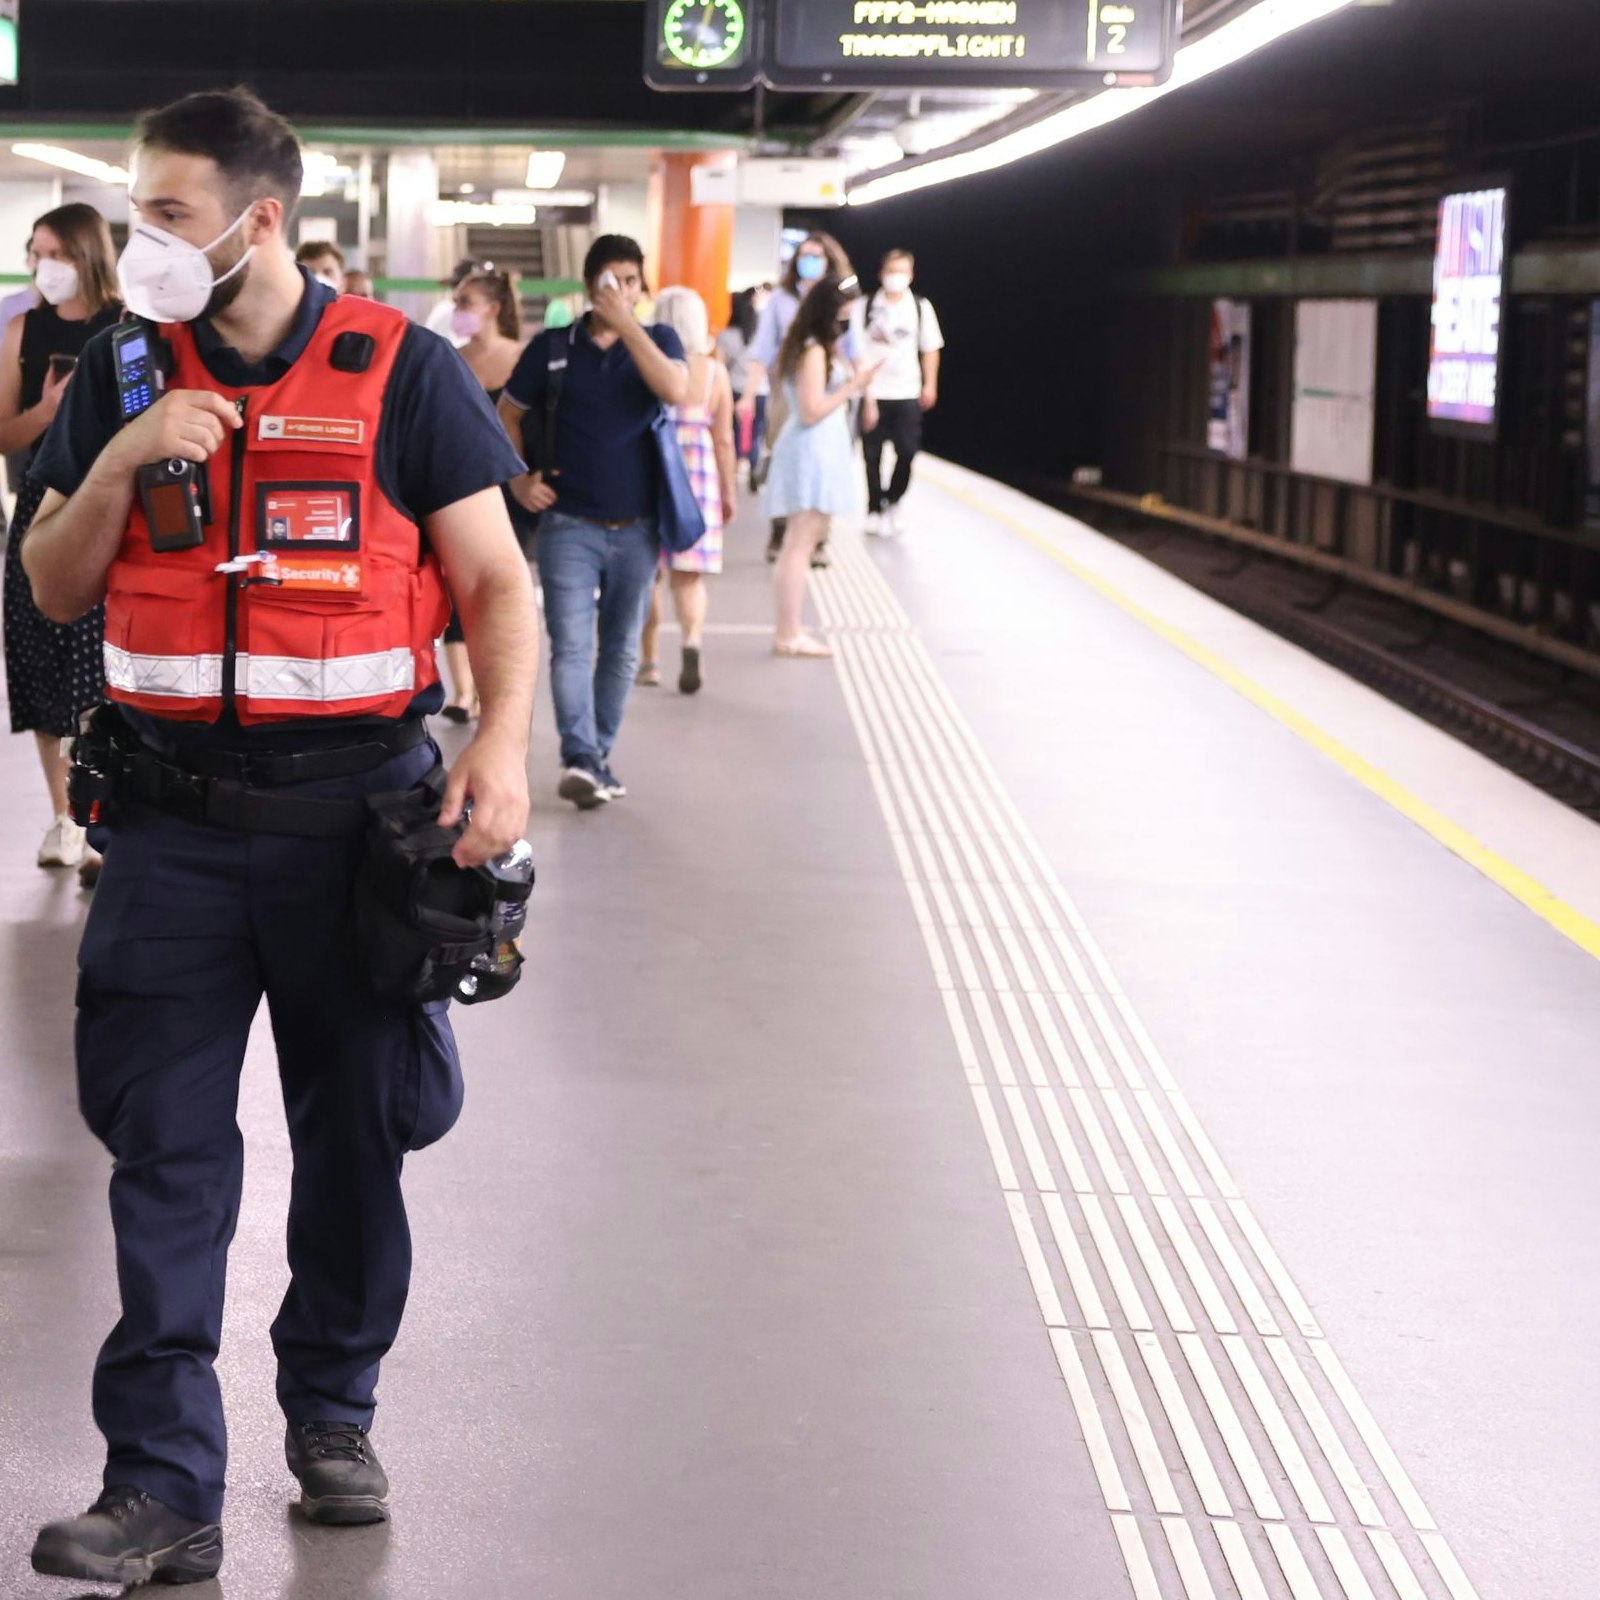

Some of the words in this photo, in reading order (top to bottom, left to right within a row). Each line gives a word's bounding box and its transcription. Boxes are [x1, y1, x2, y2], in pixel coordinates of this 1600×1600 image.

[854, 1, 1017, 24] FFP2-MASKEN
[839, 34, 1026, 57] TRAGEPFLICHT!
[1106, 25, 1126, 54] 2
[280, 567, 340, 584] Security
